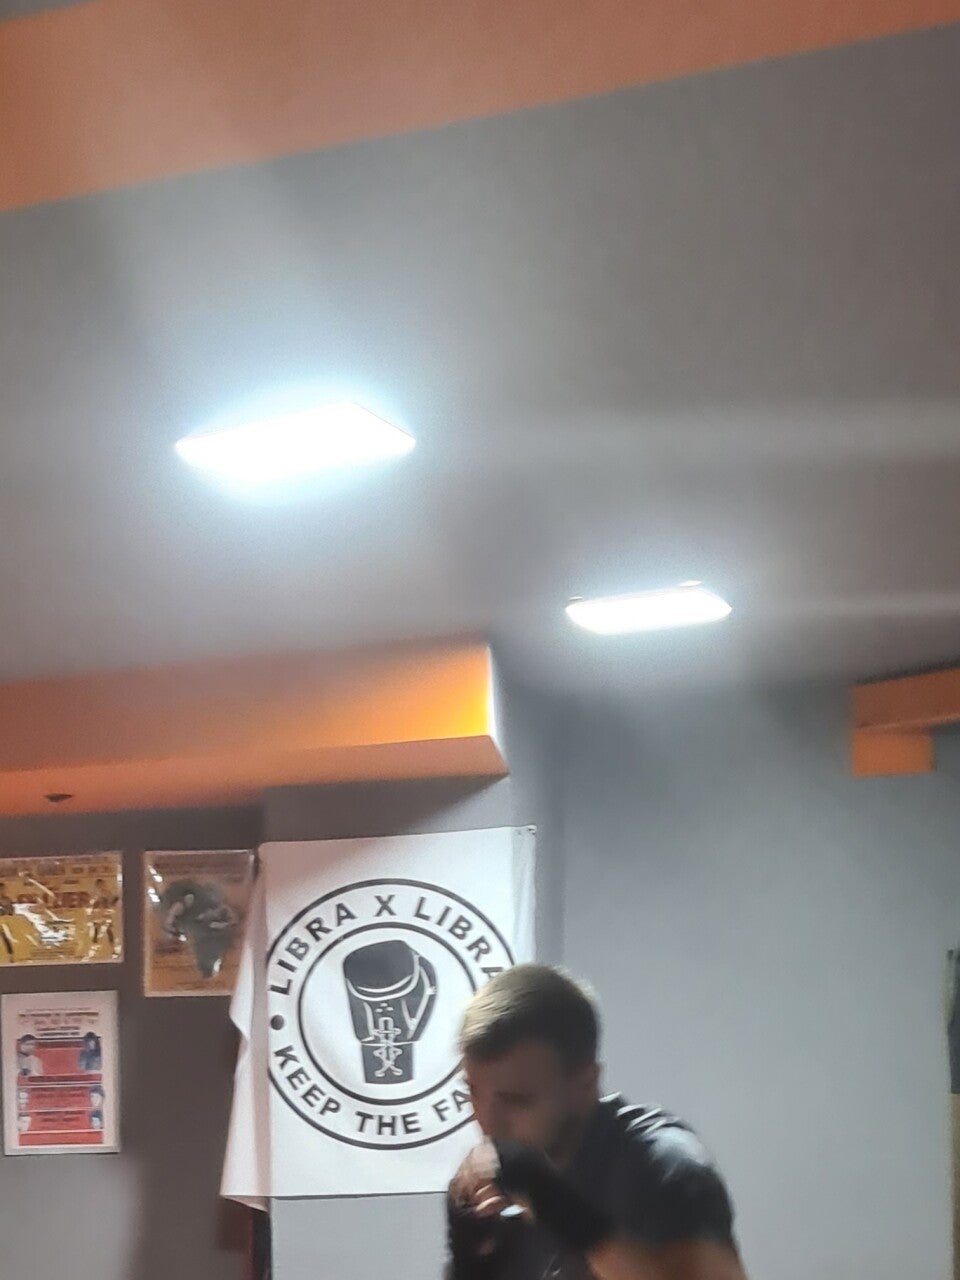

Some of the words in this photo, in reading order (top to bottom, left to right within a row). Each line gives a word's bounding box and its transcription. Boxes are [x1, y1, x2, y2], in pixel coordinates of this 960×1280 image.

[269, 902, 357, 996] LIBRA
[373, 894, 397, 918] X
[274, 1044, 341, 1116] KEEP
[355, 1111, 422, 1137] THE
[432, 1088, 471, 1123] FA
